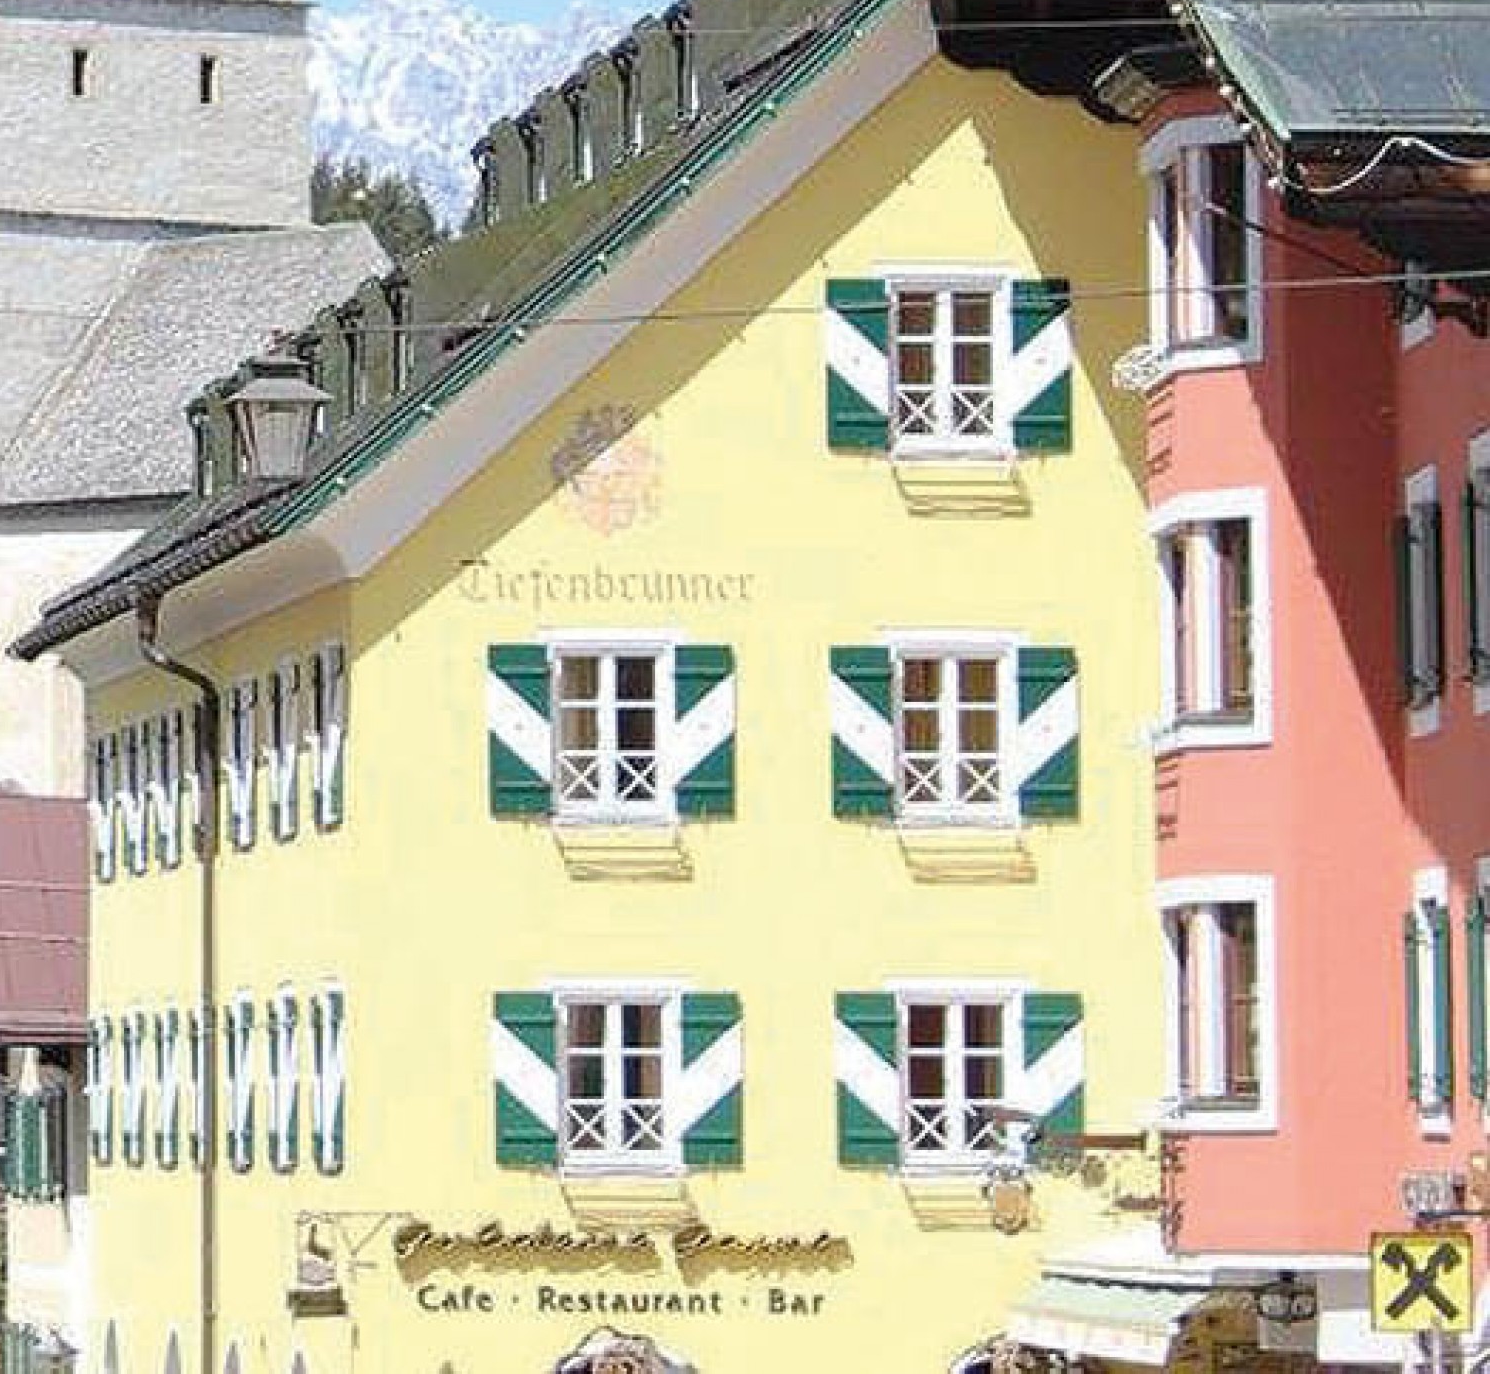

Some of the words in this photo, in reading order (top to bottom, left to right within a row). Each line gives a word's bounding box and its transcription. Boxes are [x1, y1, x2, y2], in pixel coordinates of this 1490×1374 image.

[417, 1284, 495, 1314] Cafe
[537, 1284, 722, 1316] Restaurant
[769, 1287, 825, 1316] Bar
